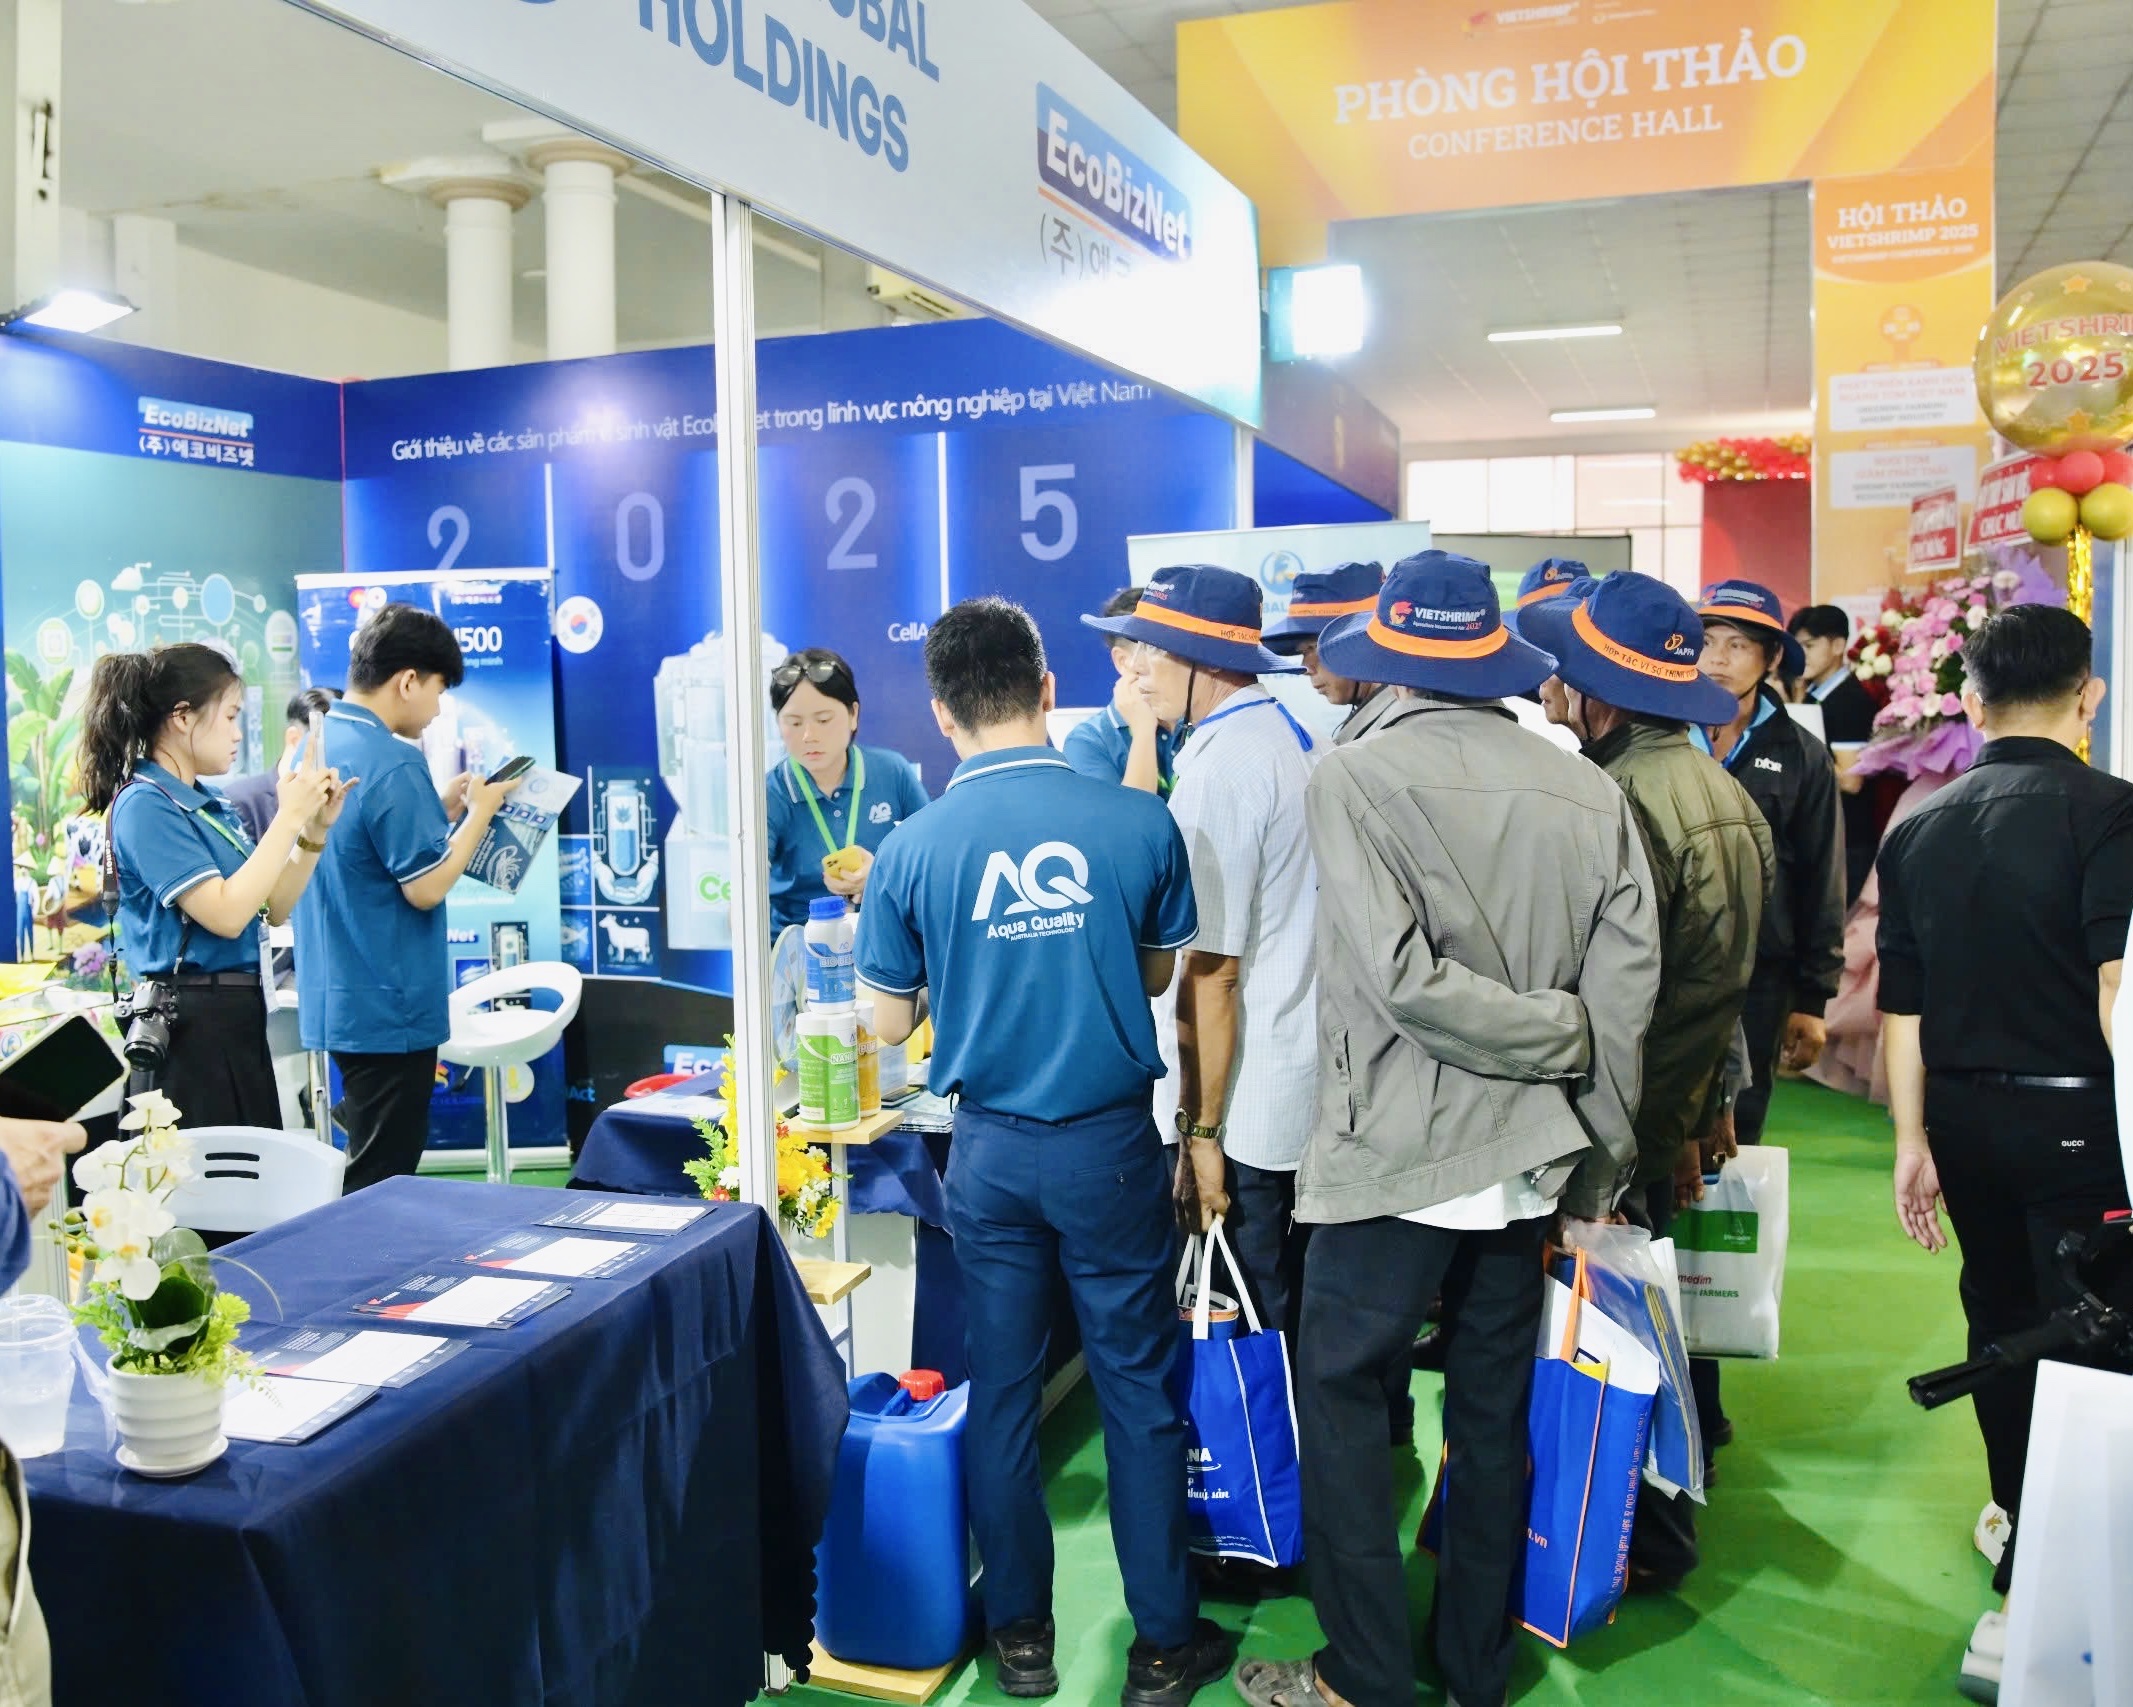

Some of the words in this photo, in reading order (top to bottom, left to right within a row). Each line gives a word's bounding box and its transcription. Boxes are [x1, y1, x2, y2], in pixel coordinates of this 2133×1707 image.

[830, 0, 940, 83] BAL
[1334, 67, 1517, 124] PHÒNG
[1531, 48, 1629, 108] HỘI
[1643, 27, 1808, 92] THẢO
[1408, 113, 1623, 160] CONFERENCE
[1631, 104, 1723, 138] HALL
[1046, 108, 1188, 258] EcoBizNet
[1837, 201, 1885, 231] HỘI
[1891, 192, 1968, 224] THẢO
[1827, 226, 1937, 250] VIETSHRIMP
[1940, 223, 1980, 241] 2025
[2028, 352, 2124, 387] 2025
[144, 403, 249, 438] EcoBizNet
[391, 438, 422, 461] Giới
[424, 436, 463, 459] thiệu
[465, 432, 485, 454] về
[487, 432, 514, 453] các
[653, 416, 680, 440] vật
[774, 408, 823, 431] trong
[827, 400, 860, 424] lĩnh
[864, 401, 898, 424] vực
[902, 393, 953, 421] nông
[957, 387, 1025, 419] nghiệp
[1028, 384, 1053, 411] tại
[1056, 381, 1098, 408] Việt
[1101, 381, 1151, 403] Nam
[139, 435, 255, 467] (주)에코비즈넷
[427, 505, 470, 569] 2
[616, 492, 665, 582] 0
[825, 477, 878, 570] 2
[1019, 463, 1078, 562] 5
[1621, 652, 1638, 667] TÁC
[1674, 647, 1695, 657] JAPFA
[971, 841, 1094, 921] AQ
[987, 920, 1027, 939] Aqua
[1031, 911, 1084, 931] Quality
[1010, 930, 1038, 941] AUSTRALIA
[1039, 927, 1075, 938] TECHNOLOGY
[1187, 1447, 1212, 1462] NA
